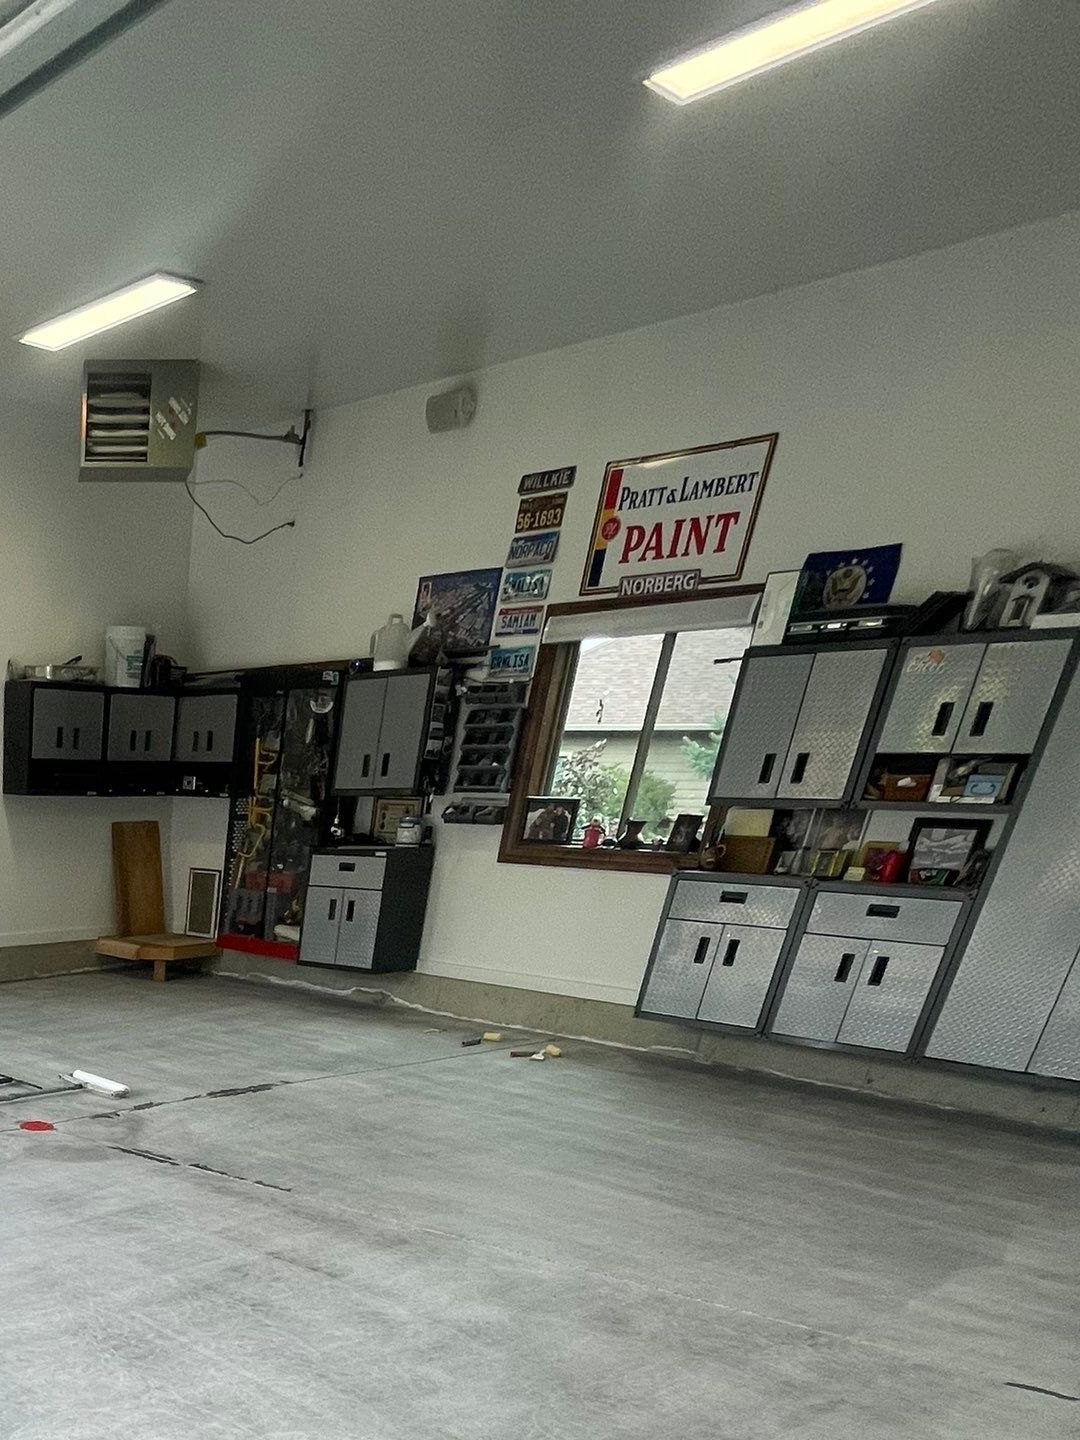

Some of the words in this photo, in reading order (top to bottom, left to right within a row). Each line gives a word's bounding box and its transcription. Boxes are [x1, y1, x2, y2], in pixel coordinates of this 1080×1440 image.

[523, 470, 571, 490] WILLKIE
[618, 511, 741, 564] PAINT
[621, 573, 696, 596] NORBERG
